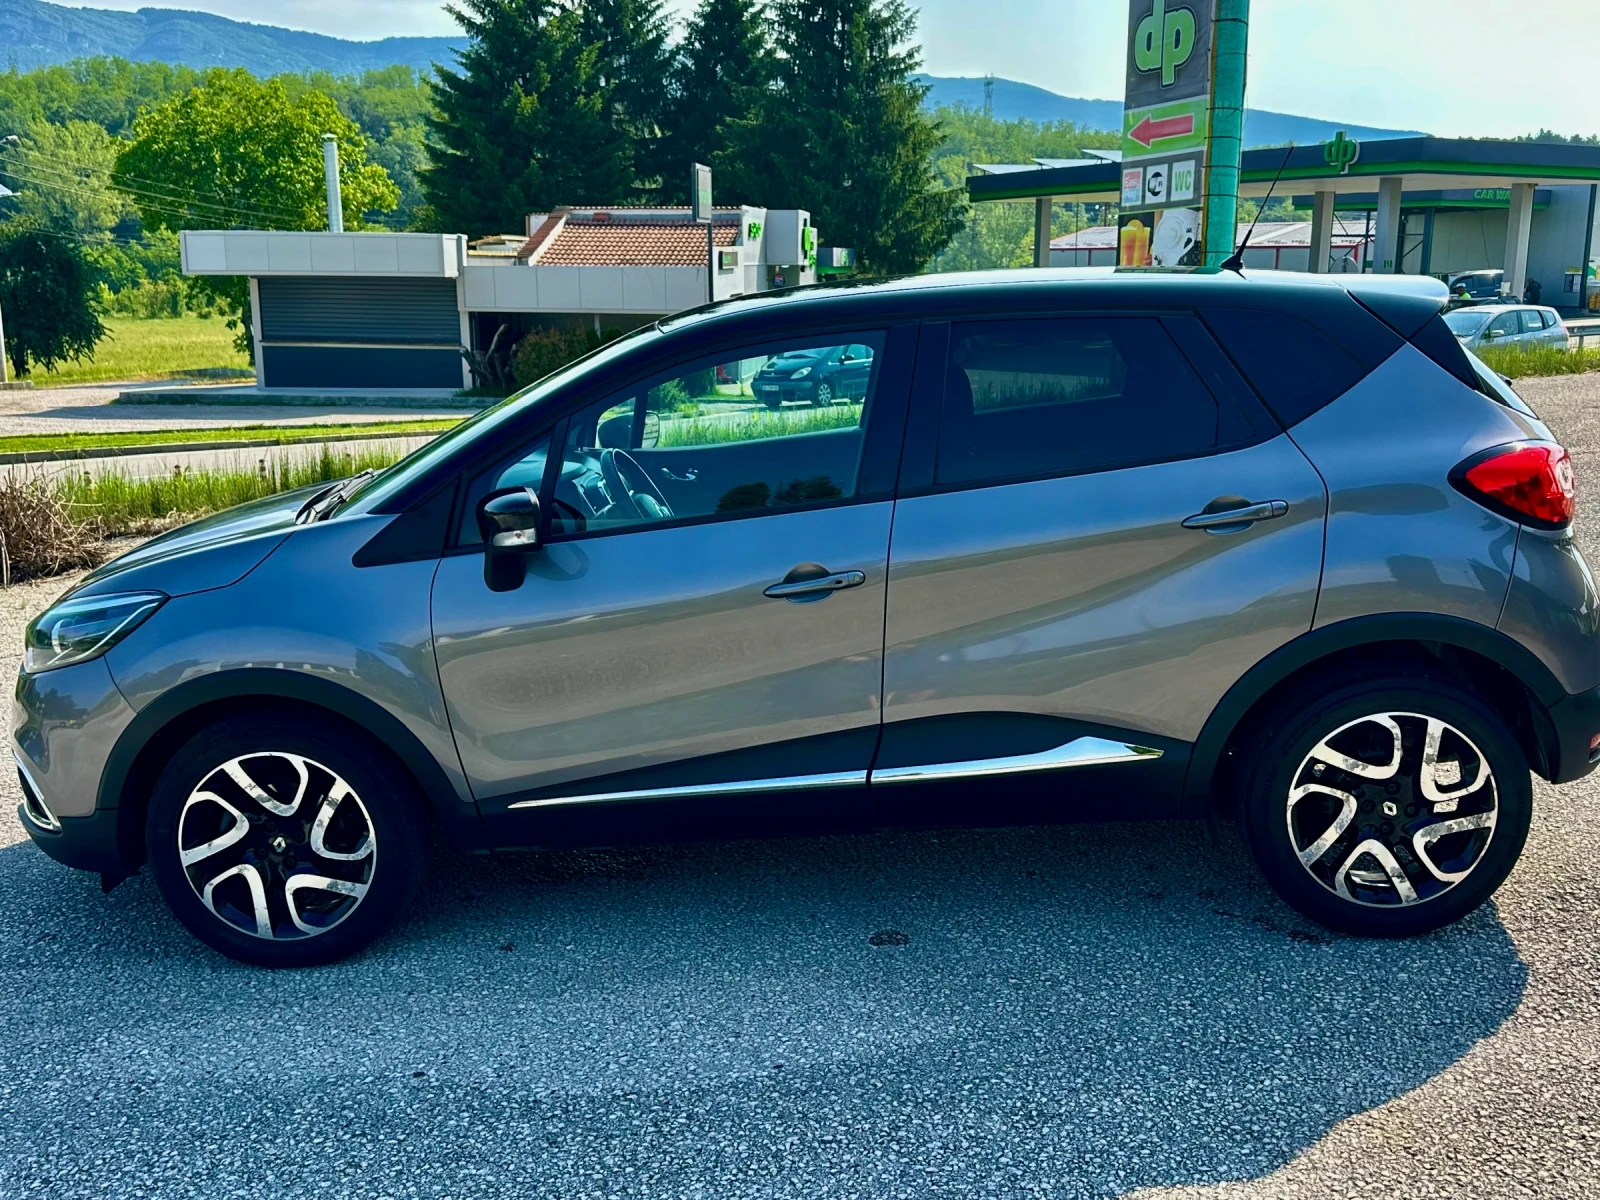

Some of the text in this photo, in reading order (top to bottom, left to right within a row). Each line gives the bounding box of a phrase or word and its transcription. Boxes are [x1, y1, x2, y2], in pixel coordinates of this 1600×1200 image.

[1134, 0, 1196, 87] dp
[1324, 131, 1359, 173] dp
[1174, 170, 1192, 192] WC
[1473, 189, 1495, 199] CAR
